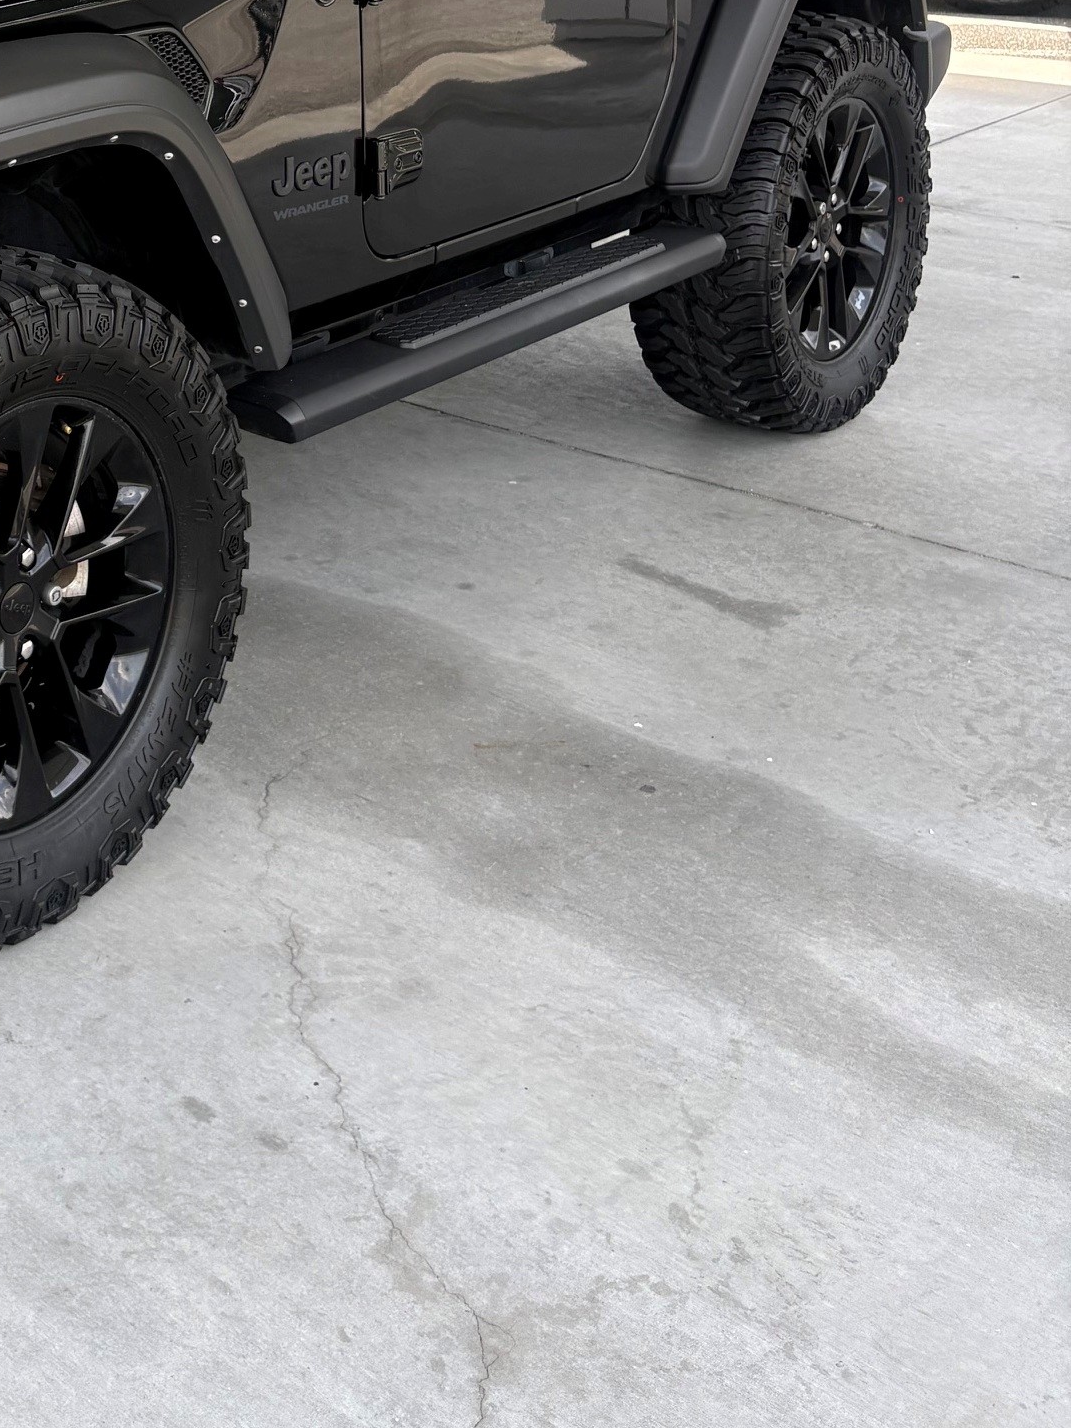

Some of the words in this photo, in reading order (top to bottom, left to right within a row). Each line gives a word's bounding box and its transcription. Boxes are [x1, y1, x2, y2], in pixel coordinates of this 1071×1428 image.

[271, 151, 351, 197] Jeep
[273, 194, 350, 221] WRANGLER
[3, 599, 31, 616] Jeep
